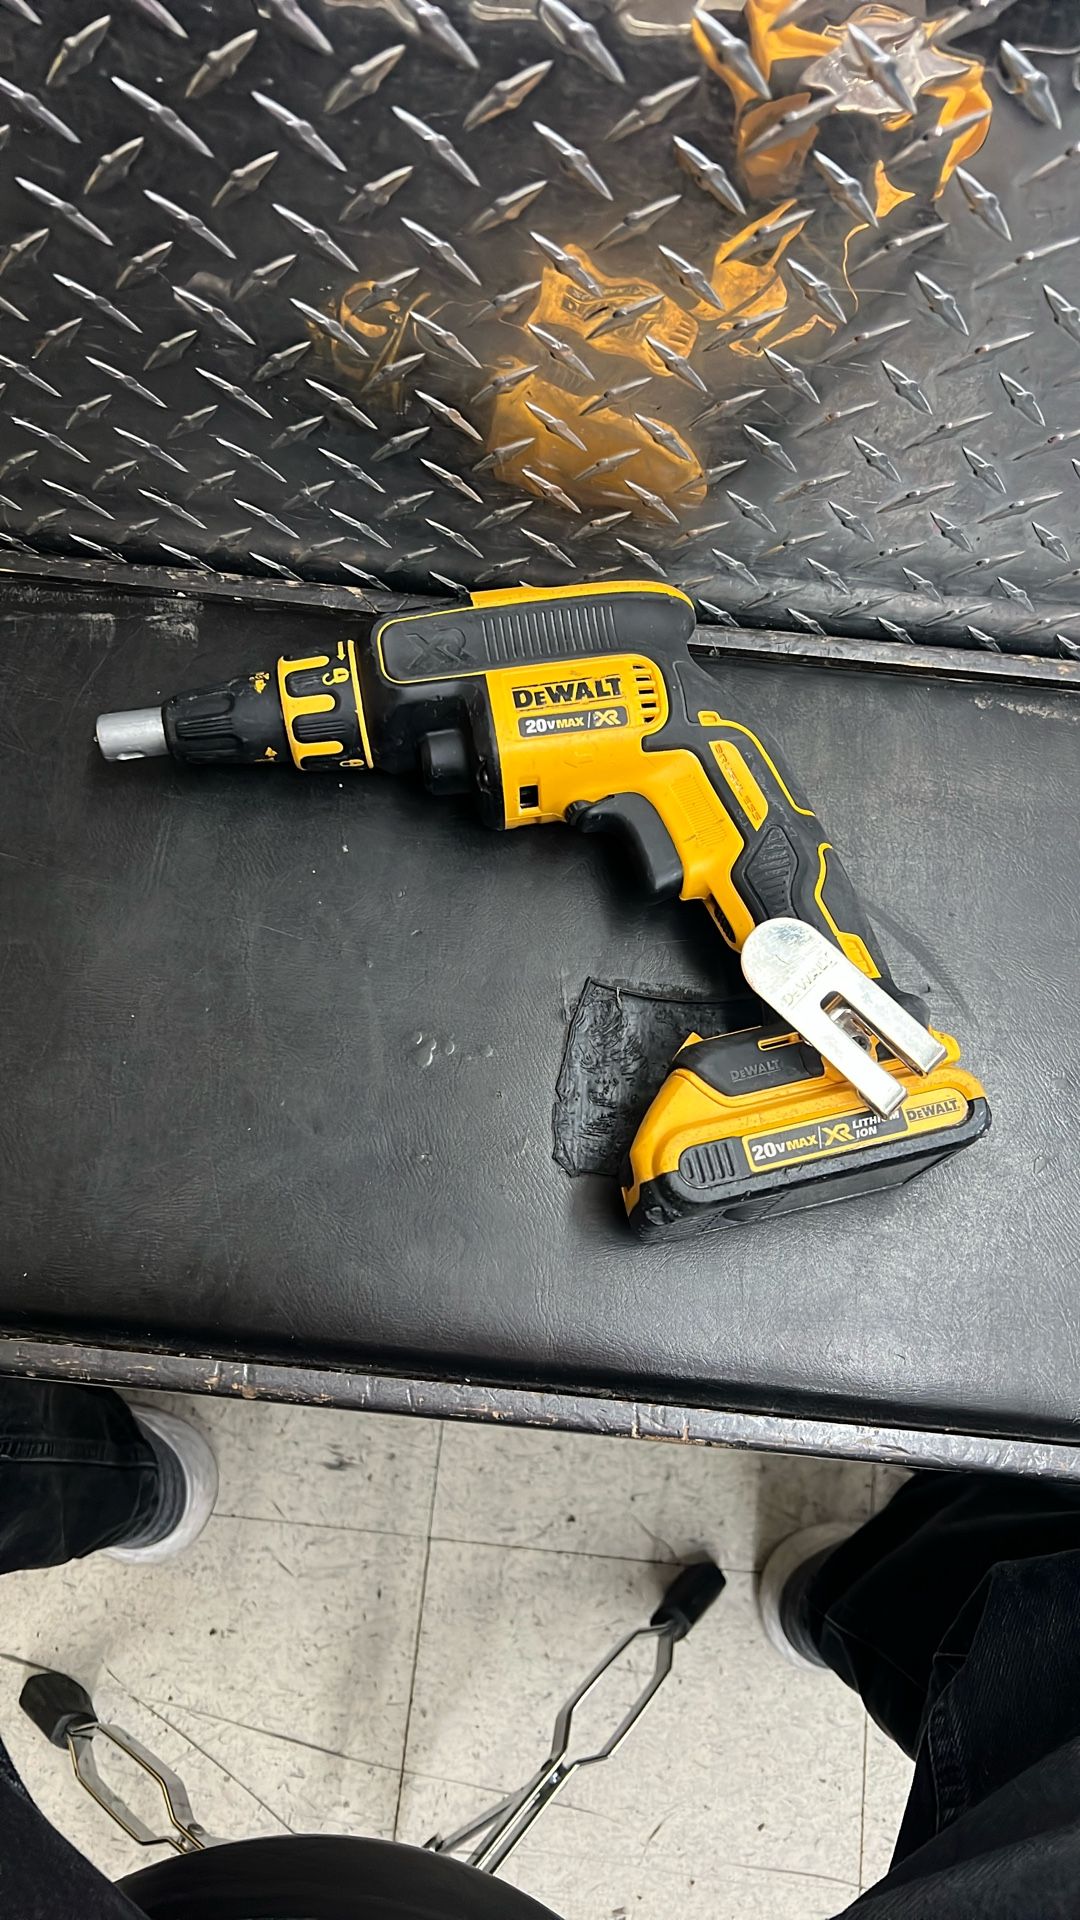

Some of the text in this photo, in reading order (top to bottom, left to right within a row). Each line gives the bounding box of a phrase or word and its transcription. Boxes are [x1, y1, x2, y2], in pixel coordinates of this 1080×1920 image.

[512, 677, 622, 709] DEWALT
[593, 709, 621, 727] XR
[730, 1058, 781, 1082] DEWALT
[852, 1110, 900, 1129] LITHIM
[906, 1099, 958, 1121] DEWALT
[822, 1122, 855, 1146] XR
[856, 1125, 878, 1139] ION
